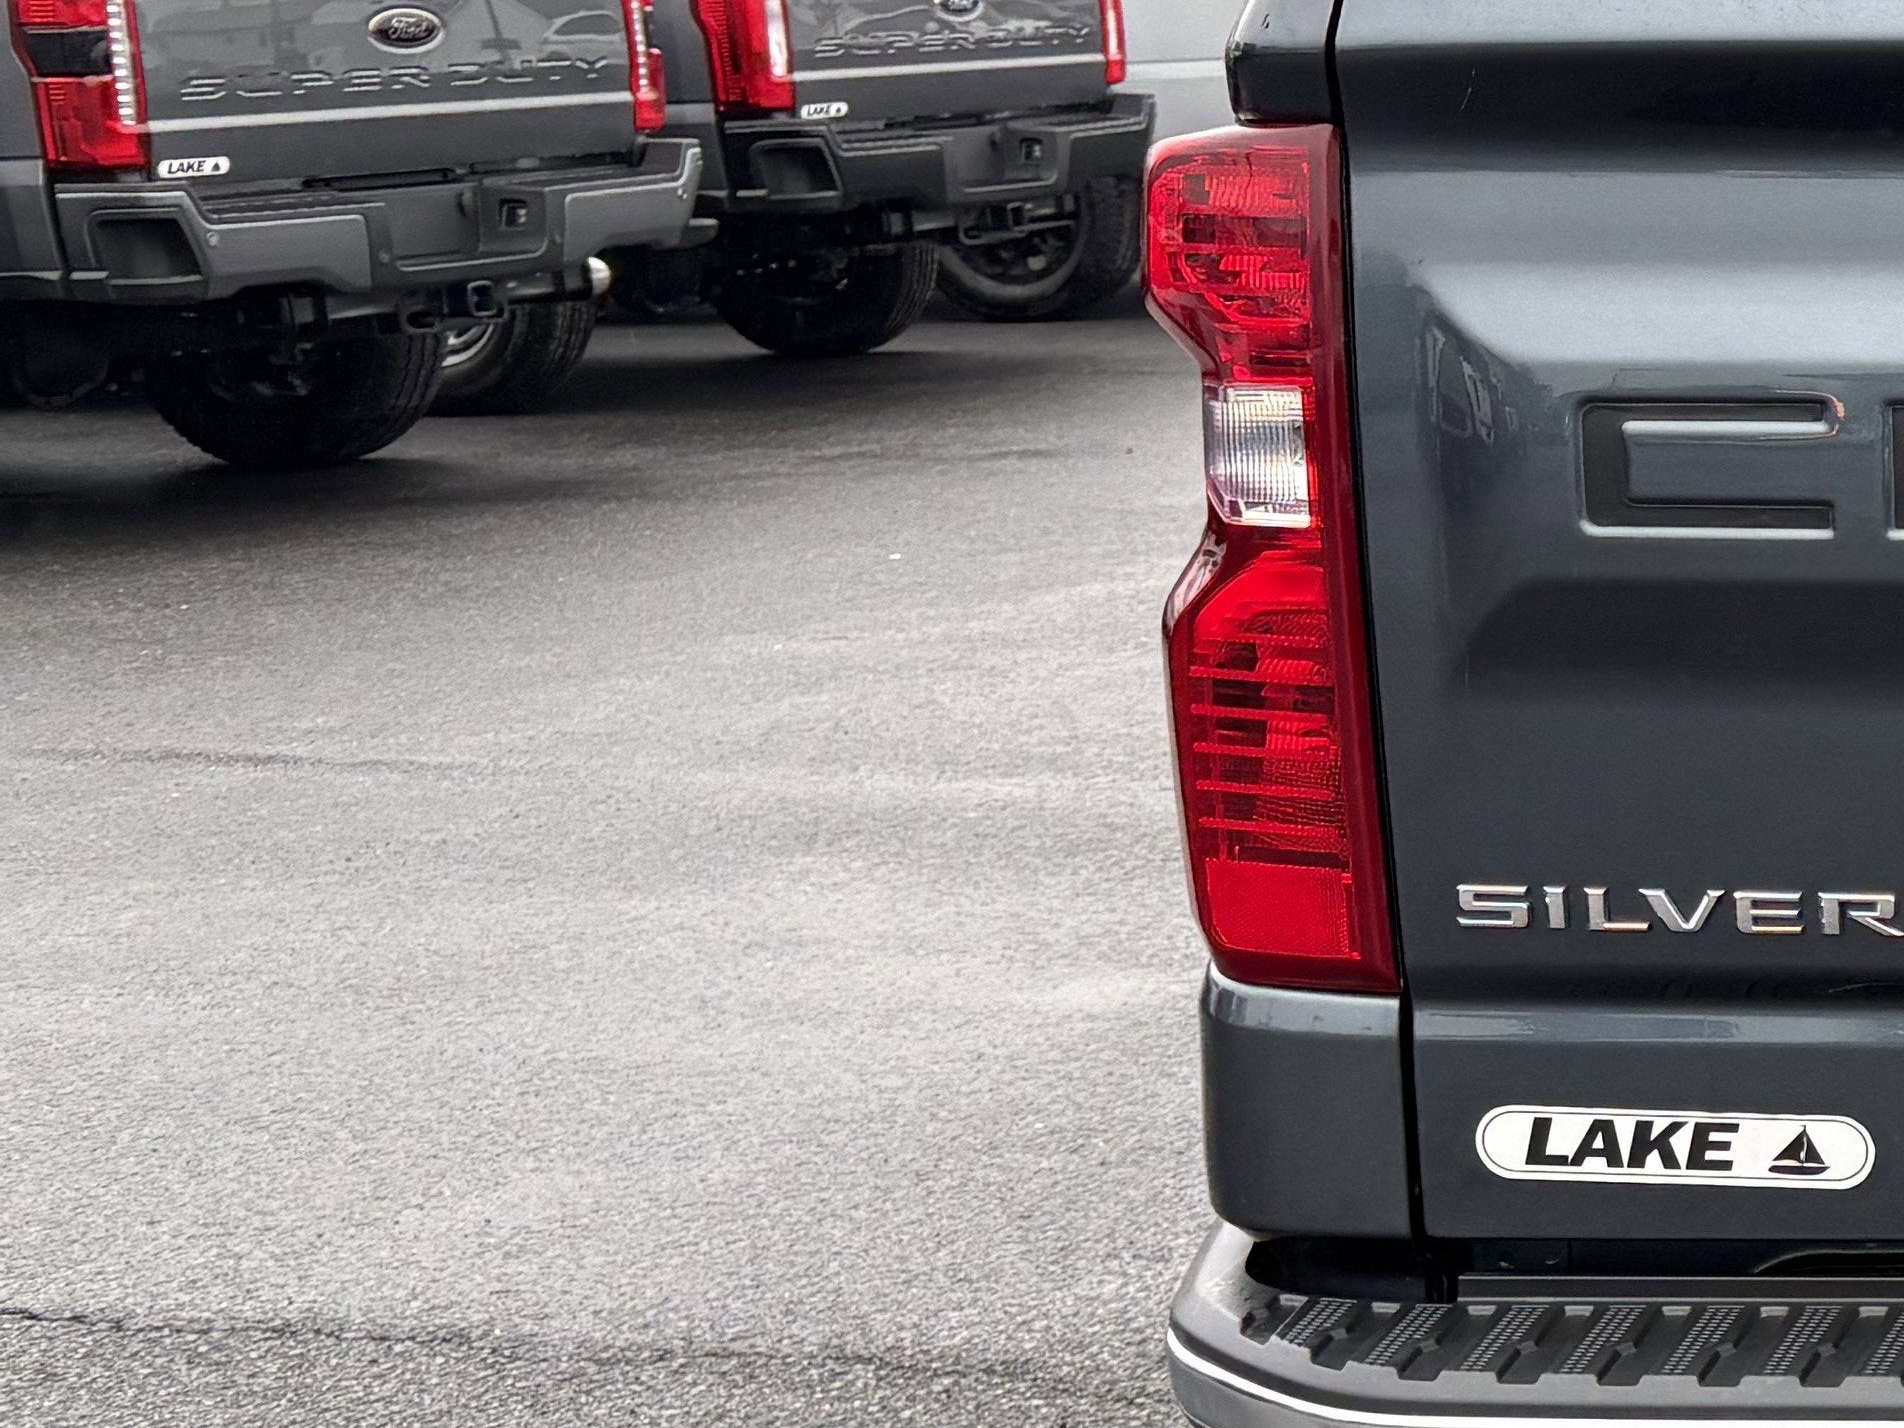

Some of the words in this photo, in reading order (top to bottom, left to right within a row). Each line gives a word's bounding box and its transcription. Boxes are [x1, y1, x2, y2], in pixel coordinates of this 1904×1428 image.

[390, 16, 431, 41] Ford
[181, 65, 431, 101] SUPER
[167, 160, 206, 174] LAKE
[1524, 1116, 1741, 1172] LAKE
